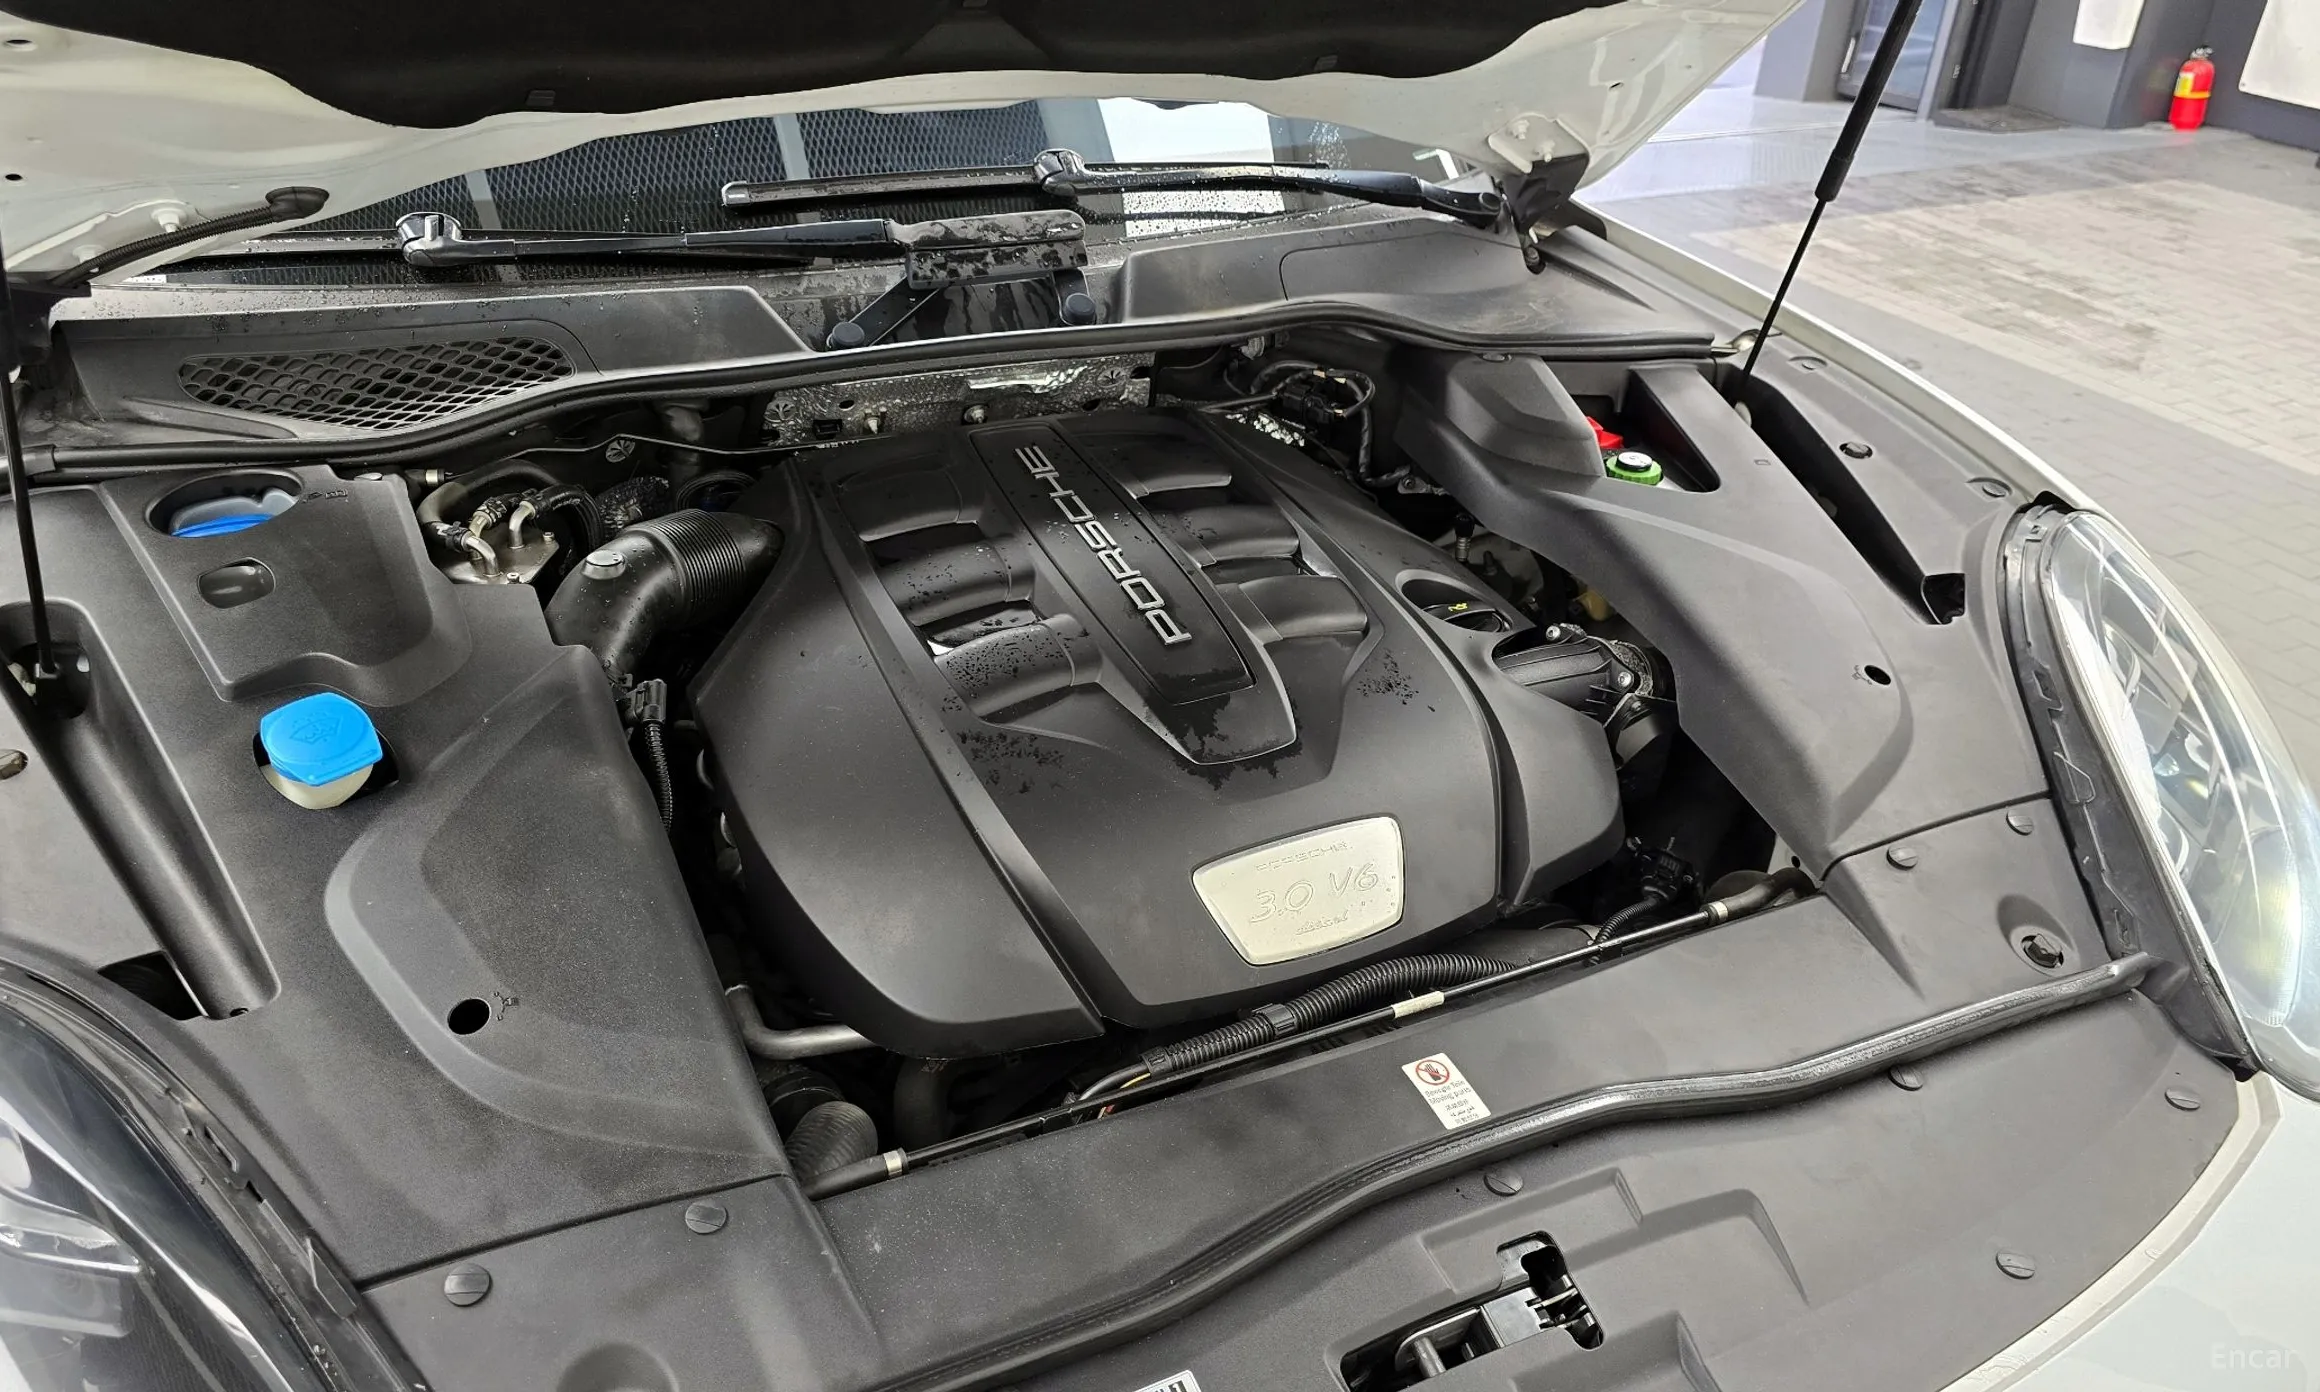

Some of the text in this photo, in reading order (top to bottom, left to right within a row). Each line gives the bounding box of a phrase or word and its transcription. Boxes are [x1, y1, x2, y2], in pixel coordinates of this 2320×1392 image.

[1014, 445, 1192, 646] PORSCHE
[1250, 863, 1379, 923] 3.0 V6
